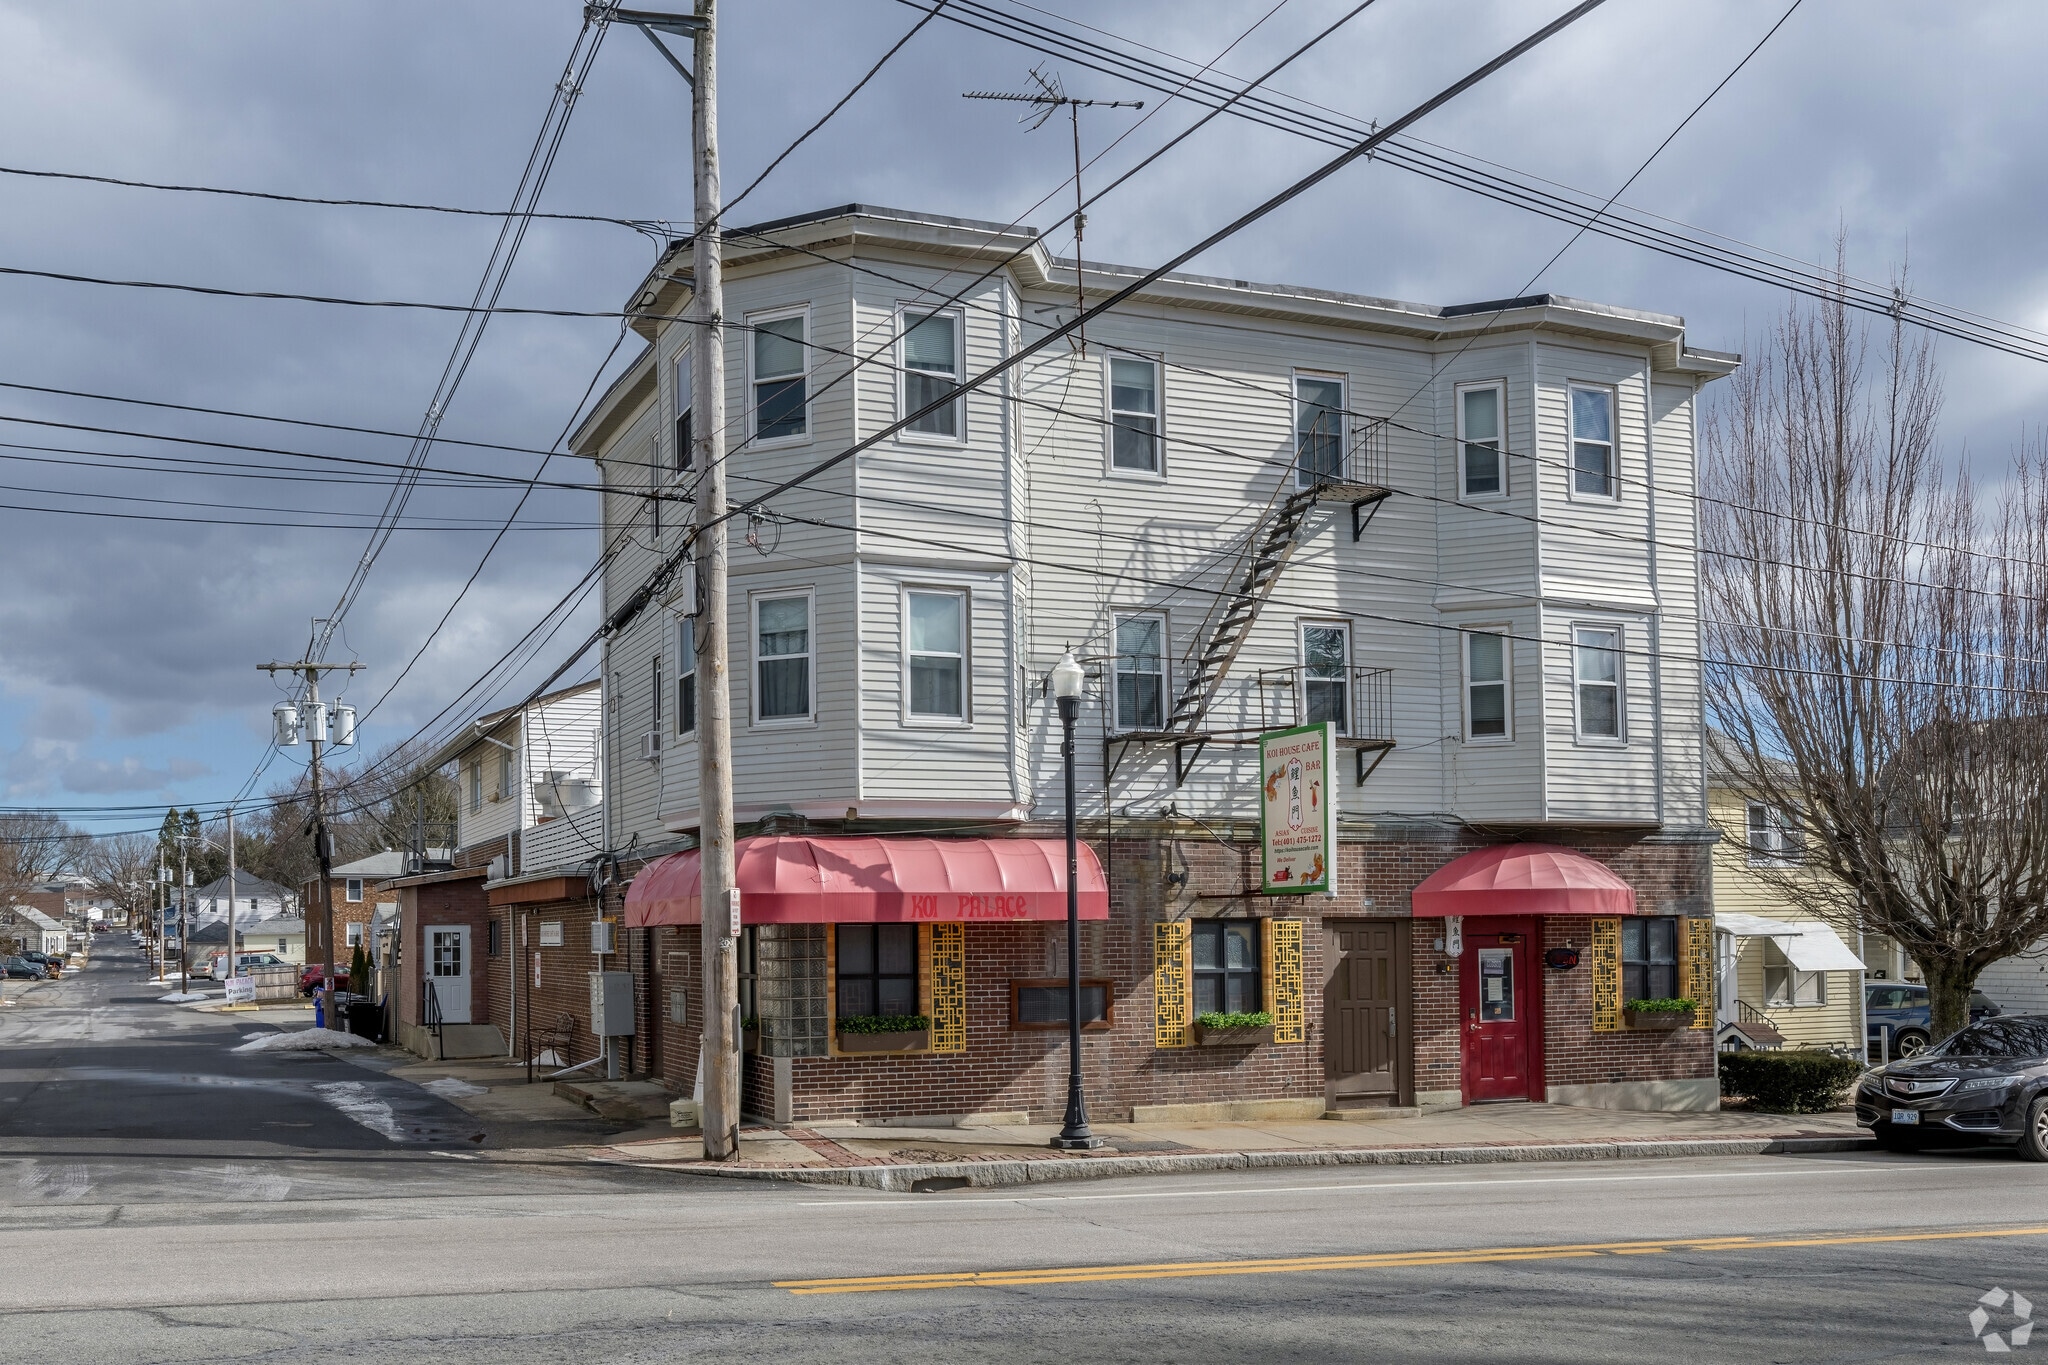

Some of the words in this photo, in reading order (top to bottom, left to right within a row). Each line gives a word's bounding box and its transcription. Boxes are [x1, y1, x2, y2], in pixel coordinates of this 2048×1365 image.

[1267, 749, 1278, 759] KOI
[1279, 745, 1301, 757] HOUSE
[1301, 741, 1320, 753] CAFE
[1305, 760, 1321, 771] BAR
[1301, 826, 1319, 834] CUISINE
[1296, 834, 1321, 844] 475-1272
[910, 895, 938, 919] KOI
[956, 895, 1027, 918] PALACE
[228, 986, 253, 996] Parking
[1906, 1112, 1918, 1121] 929
